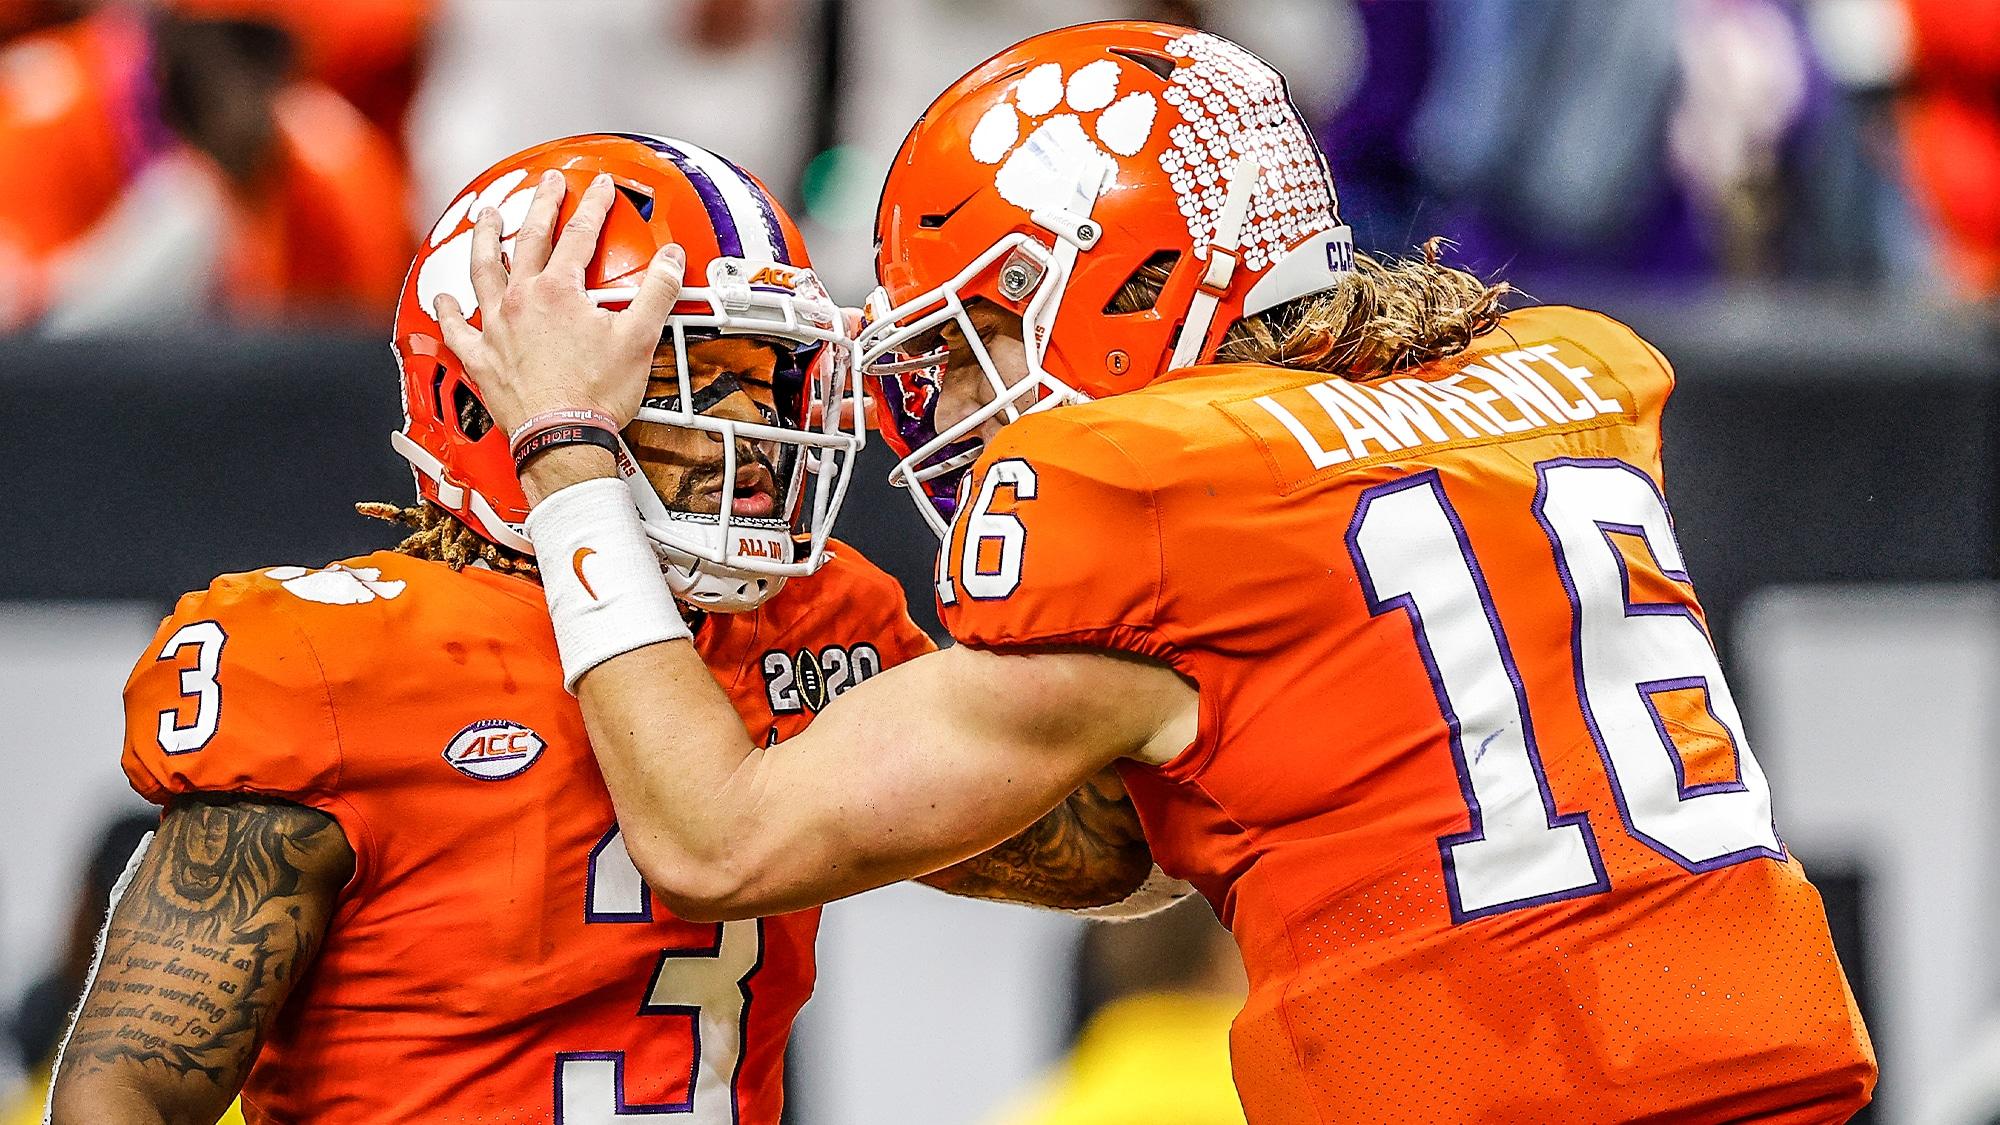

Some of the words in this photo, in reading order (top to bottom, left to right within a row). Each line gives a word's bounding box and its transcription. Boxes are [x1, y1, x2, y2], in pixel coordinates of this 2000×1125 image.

[748, 267, 796, 290] ACC
[1254, 343, 1624, 470] LAWRENCE
[541, 428, 583, 446] HOPE
[737, 538, 767, 557] ALL
[767, 540, 782, 561] IN
[934, 457, 1038, 608] 16
[156, 619, 229, 757] 3
[1344, 456, 1788, 925] 16
[459, 731, 529, 759] ACC
[119, 956, 161, 974] your
[218, 980, 238, 994] as
[191, 944, 235, 964] work
[233, 958, 252, 971] as
[553, 822, 766, 1125] 3
[159, 987, 226, 1023] working
[149, 1011, 179, 1027] not
[174, 1018, 211, 1037] for
